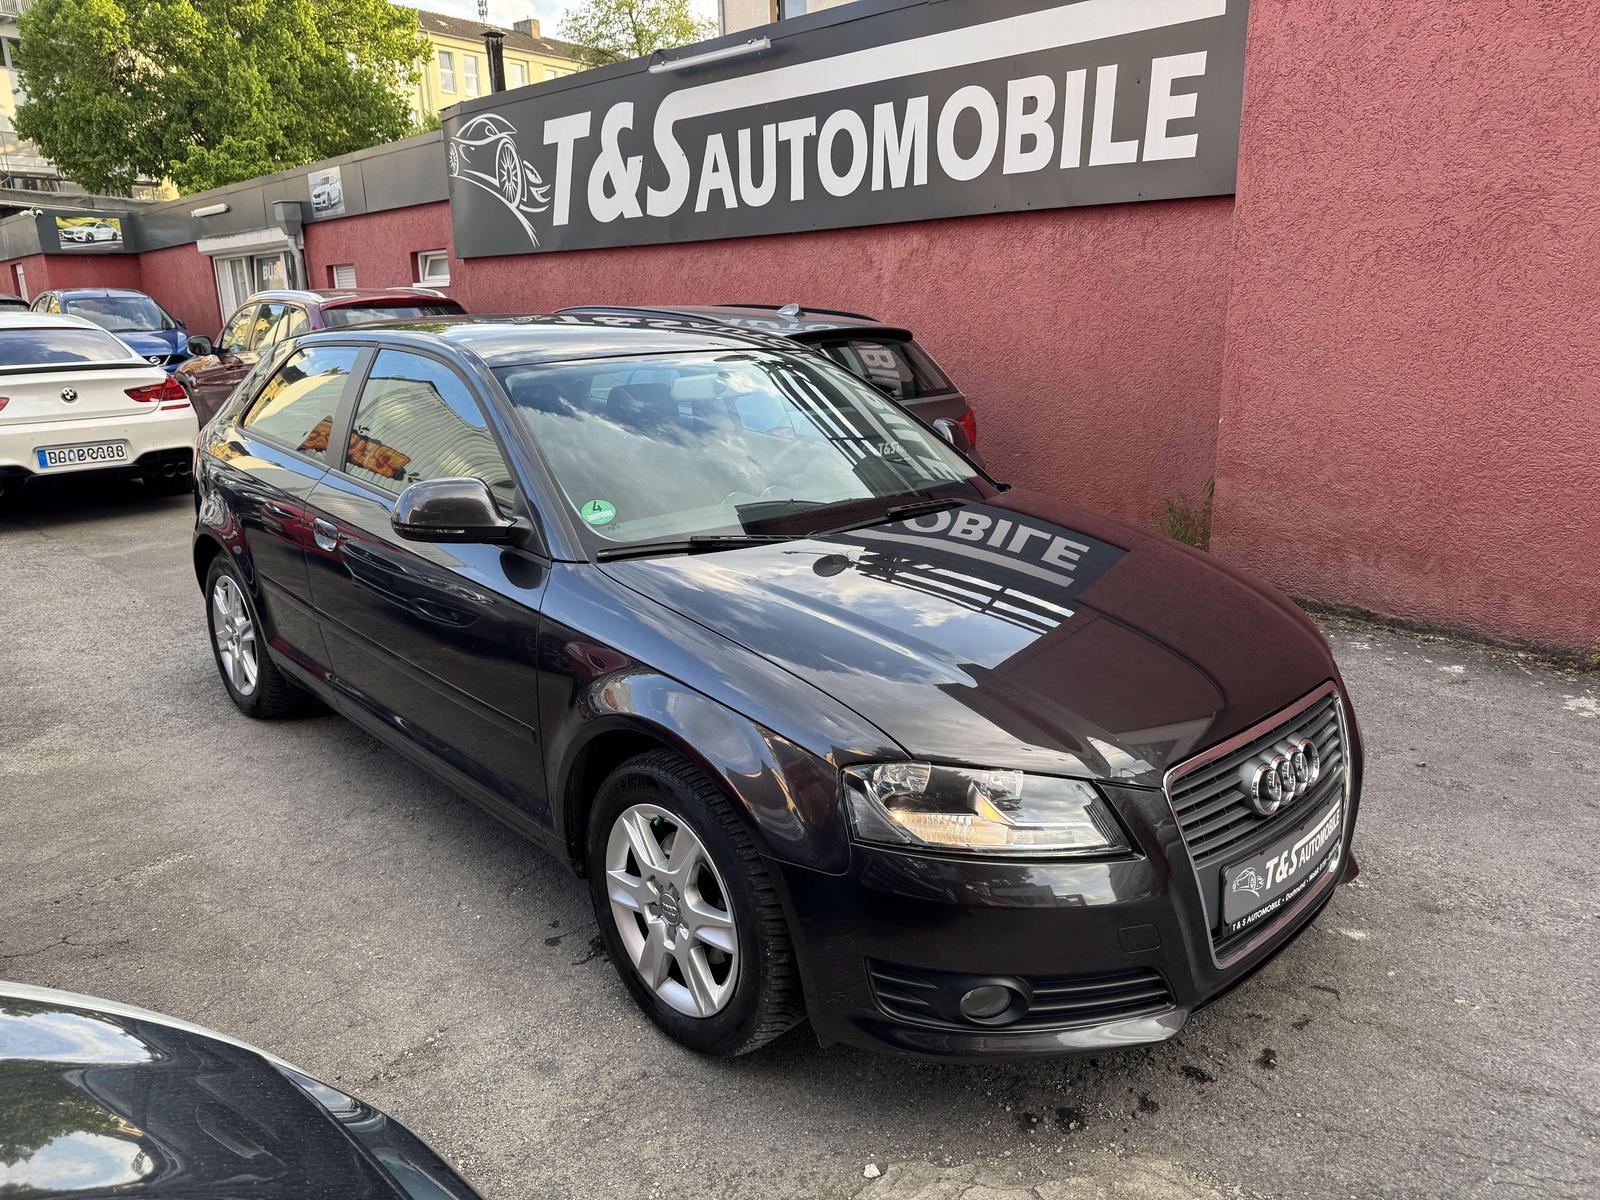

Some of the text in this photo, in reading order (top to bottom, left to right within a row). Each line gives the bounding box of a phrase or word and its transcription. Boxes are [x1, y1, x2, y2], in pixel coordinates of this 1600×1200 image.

[694, 51, 1208, 213] AUTOMOBILE
[592, 500, 603, 512] 4
[1247, 898, 1281, 923] AUTOMOBILE
